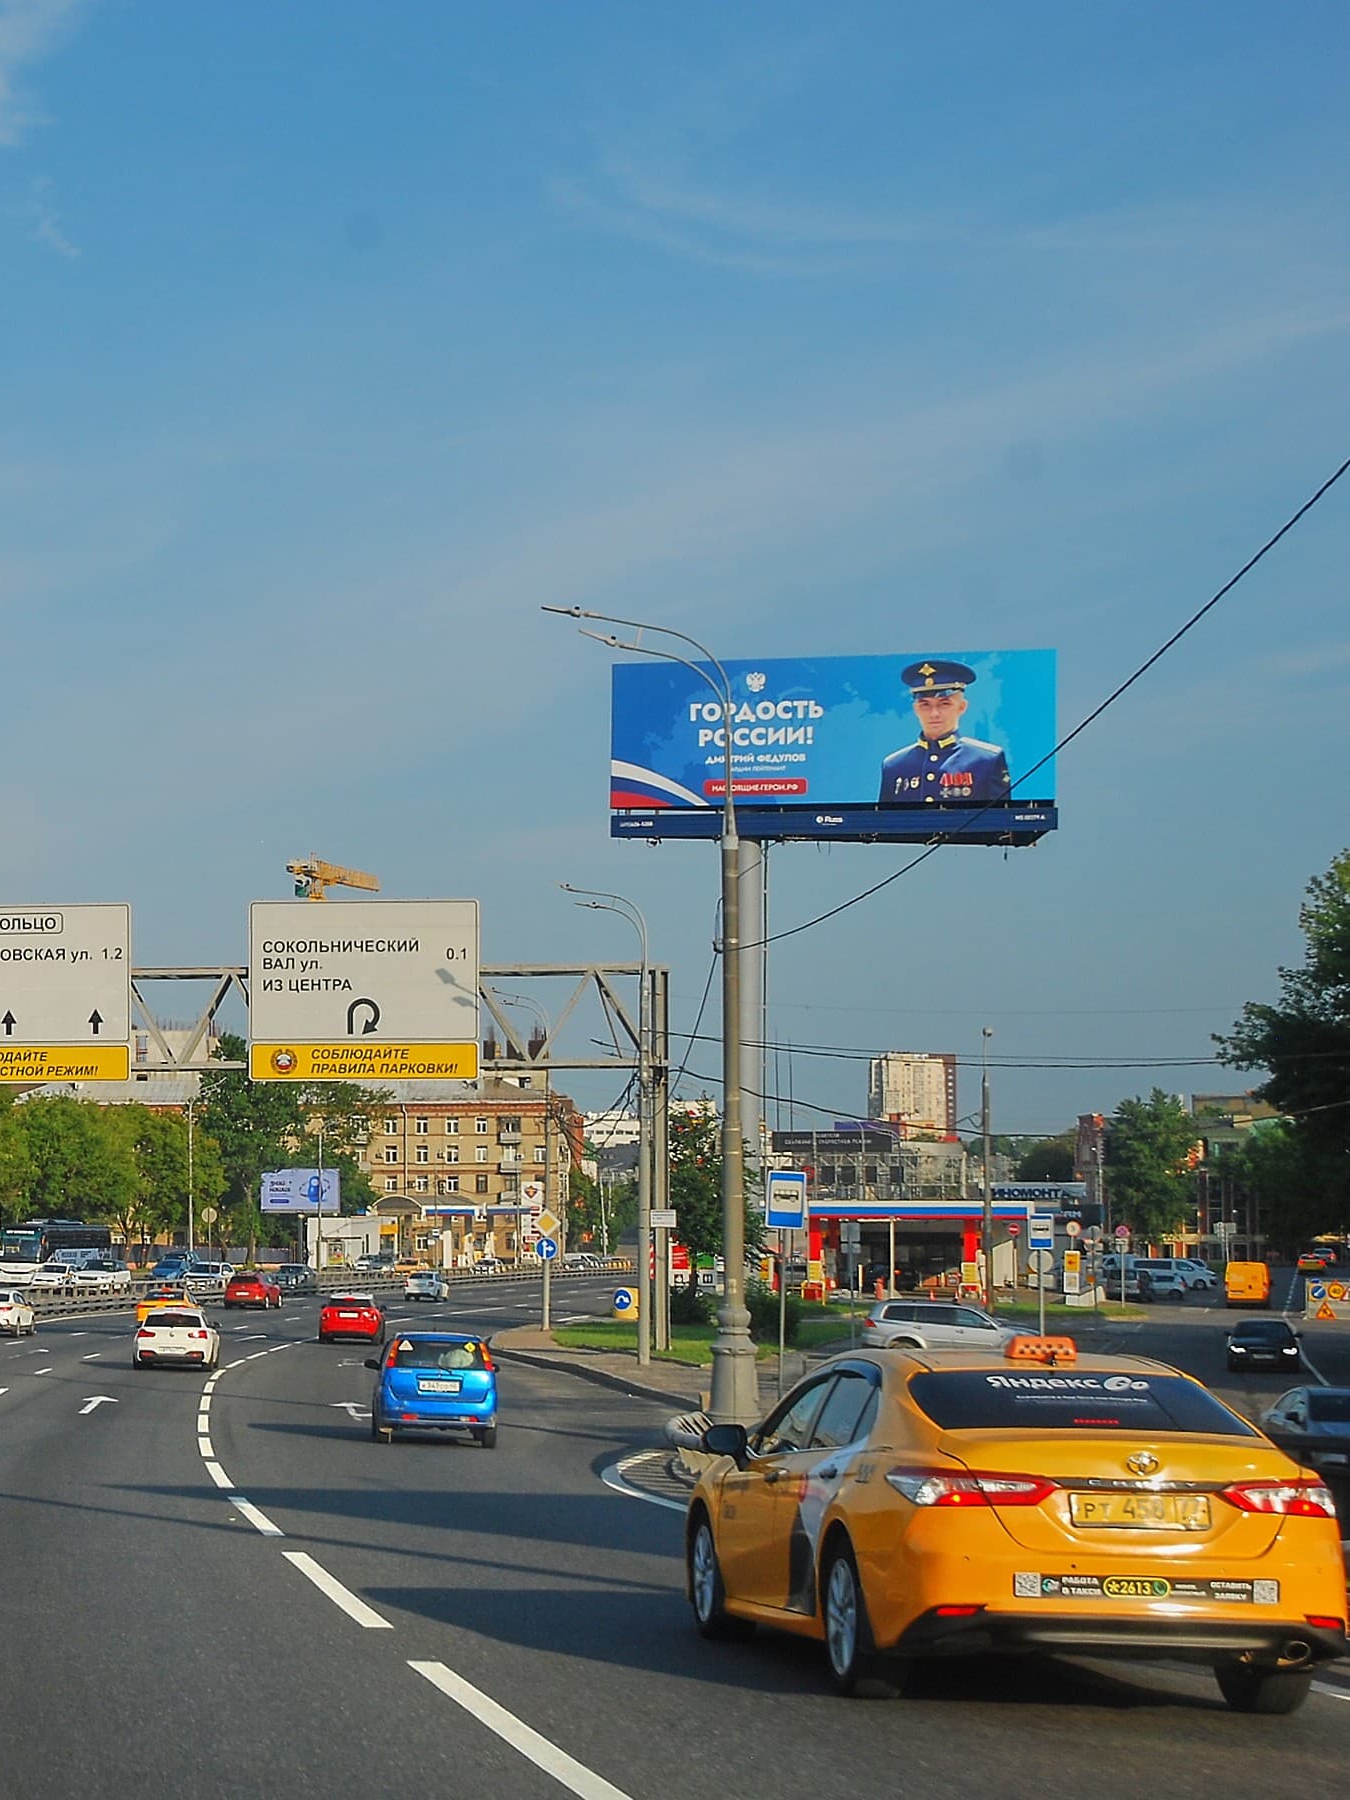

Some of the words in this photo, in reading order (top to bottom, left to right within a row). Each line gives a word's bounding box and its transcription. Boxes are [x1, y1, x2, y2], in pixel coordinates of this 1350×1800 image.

[689, 700, 824, 723] ГОРДОСТЬ
[698, 726, 814, 747] РОССИИ!
[262, 937, 420, 953] СОКОЛЬНИЧЕСКИЙ
[70, 951, 93, 963] ул.
[101, 947, 123, 960] 1.2
[445, 948, 467, 960] 0.1
[262, 958, 295, 970] ВАЛ
[299, 959, 323, 972] ул.
[262, 979, 284, 991] ИЗ
[288, 978, 353, 993] ЦЕНТРА
[311, 1047, 410, 1061] СОБЛЮДАЙТЕ
[46, 1065, 99, 1076] РЕЖИМ!
[310, 1063, 375, 1074] ПРАВИЛА
[379, 1063, 458, 1074] ПАРКОВКИ!
[986, 1375, 1100, 1390] Яндекс
[1103, 1376, 1150, 1391] Go
[1061, 1576, 1099, 1585] РАБОТА
